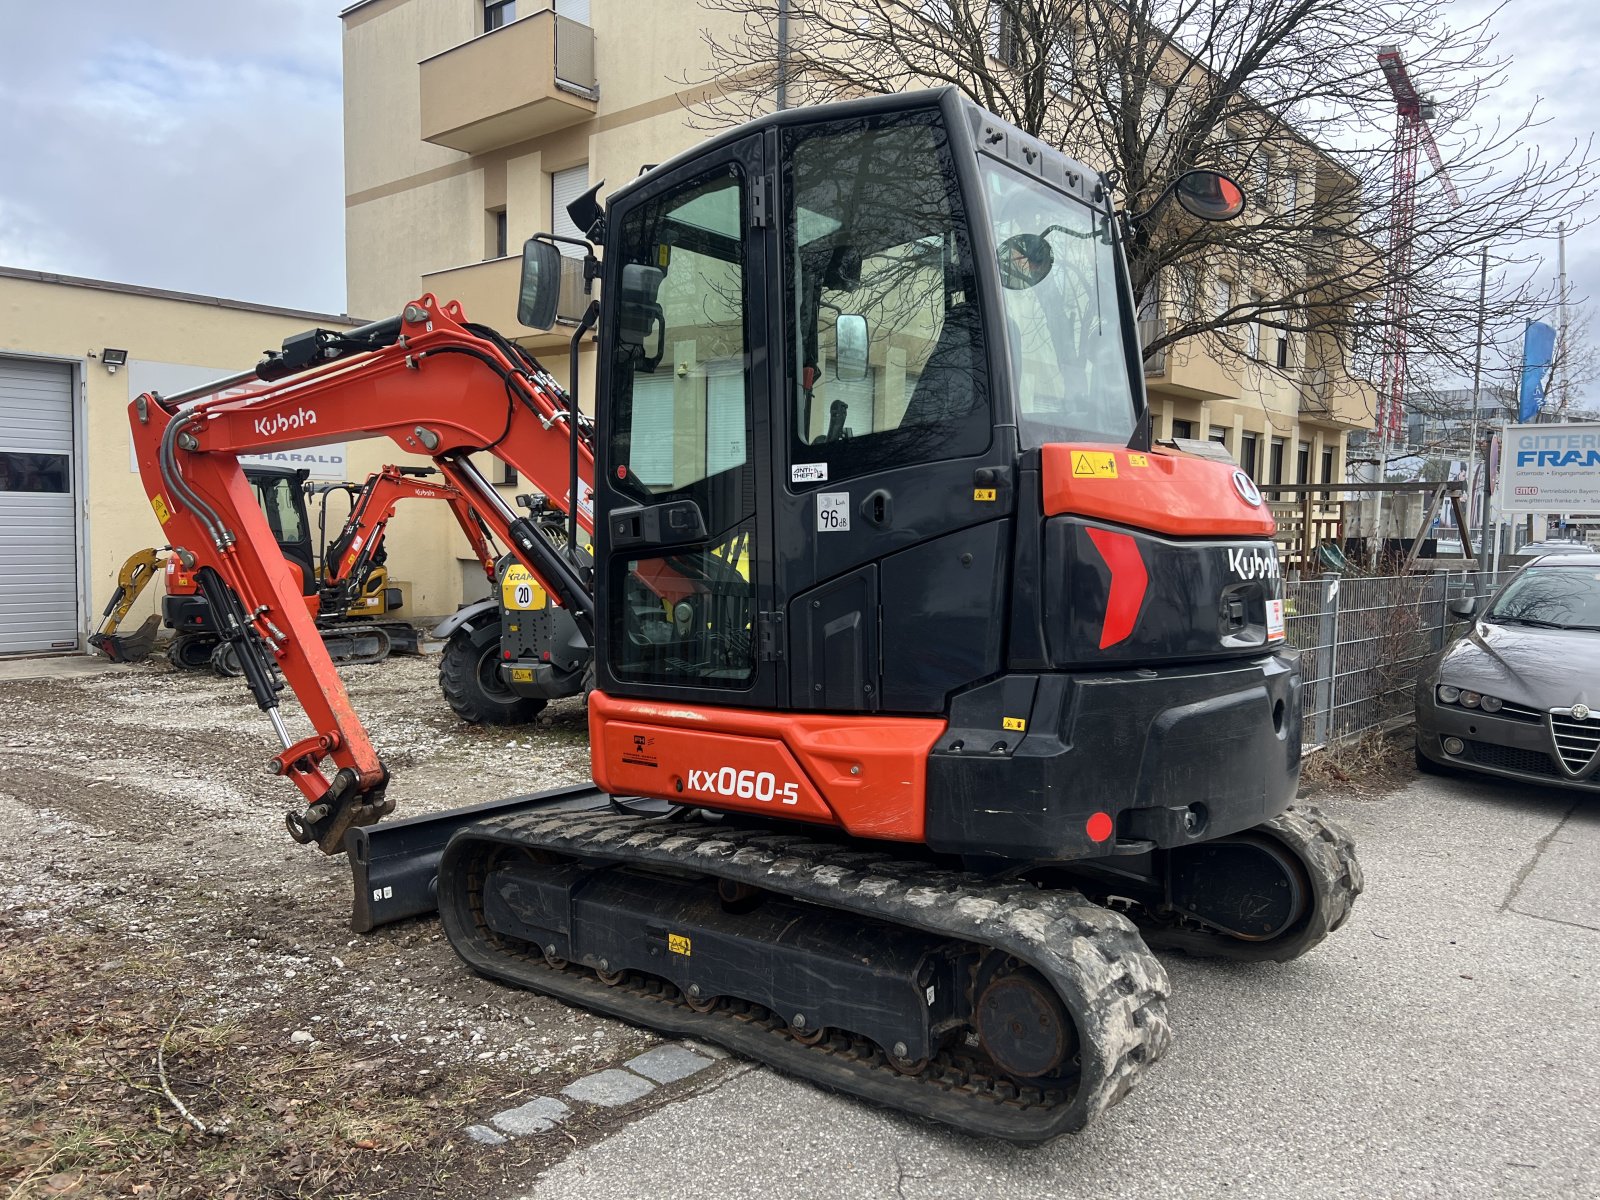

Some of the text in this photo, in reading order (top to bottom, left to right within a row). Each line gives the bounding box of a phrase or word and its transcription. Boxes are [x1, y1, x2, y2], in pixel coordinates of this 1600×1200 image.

[255, 407, 317, 436] Kubota
[1518, 434, 1600, 450] GITTER
[820, 510, 838, 528] 96
[518, 587, 529, 604] 20
[687, 766, 799, 805] KX060-5
